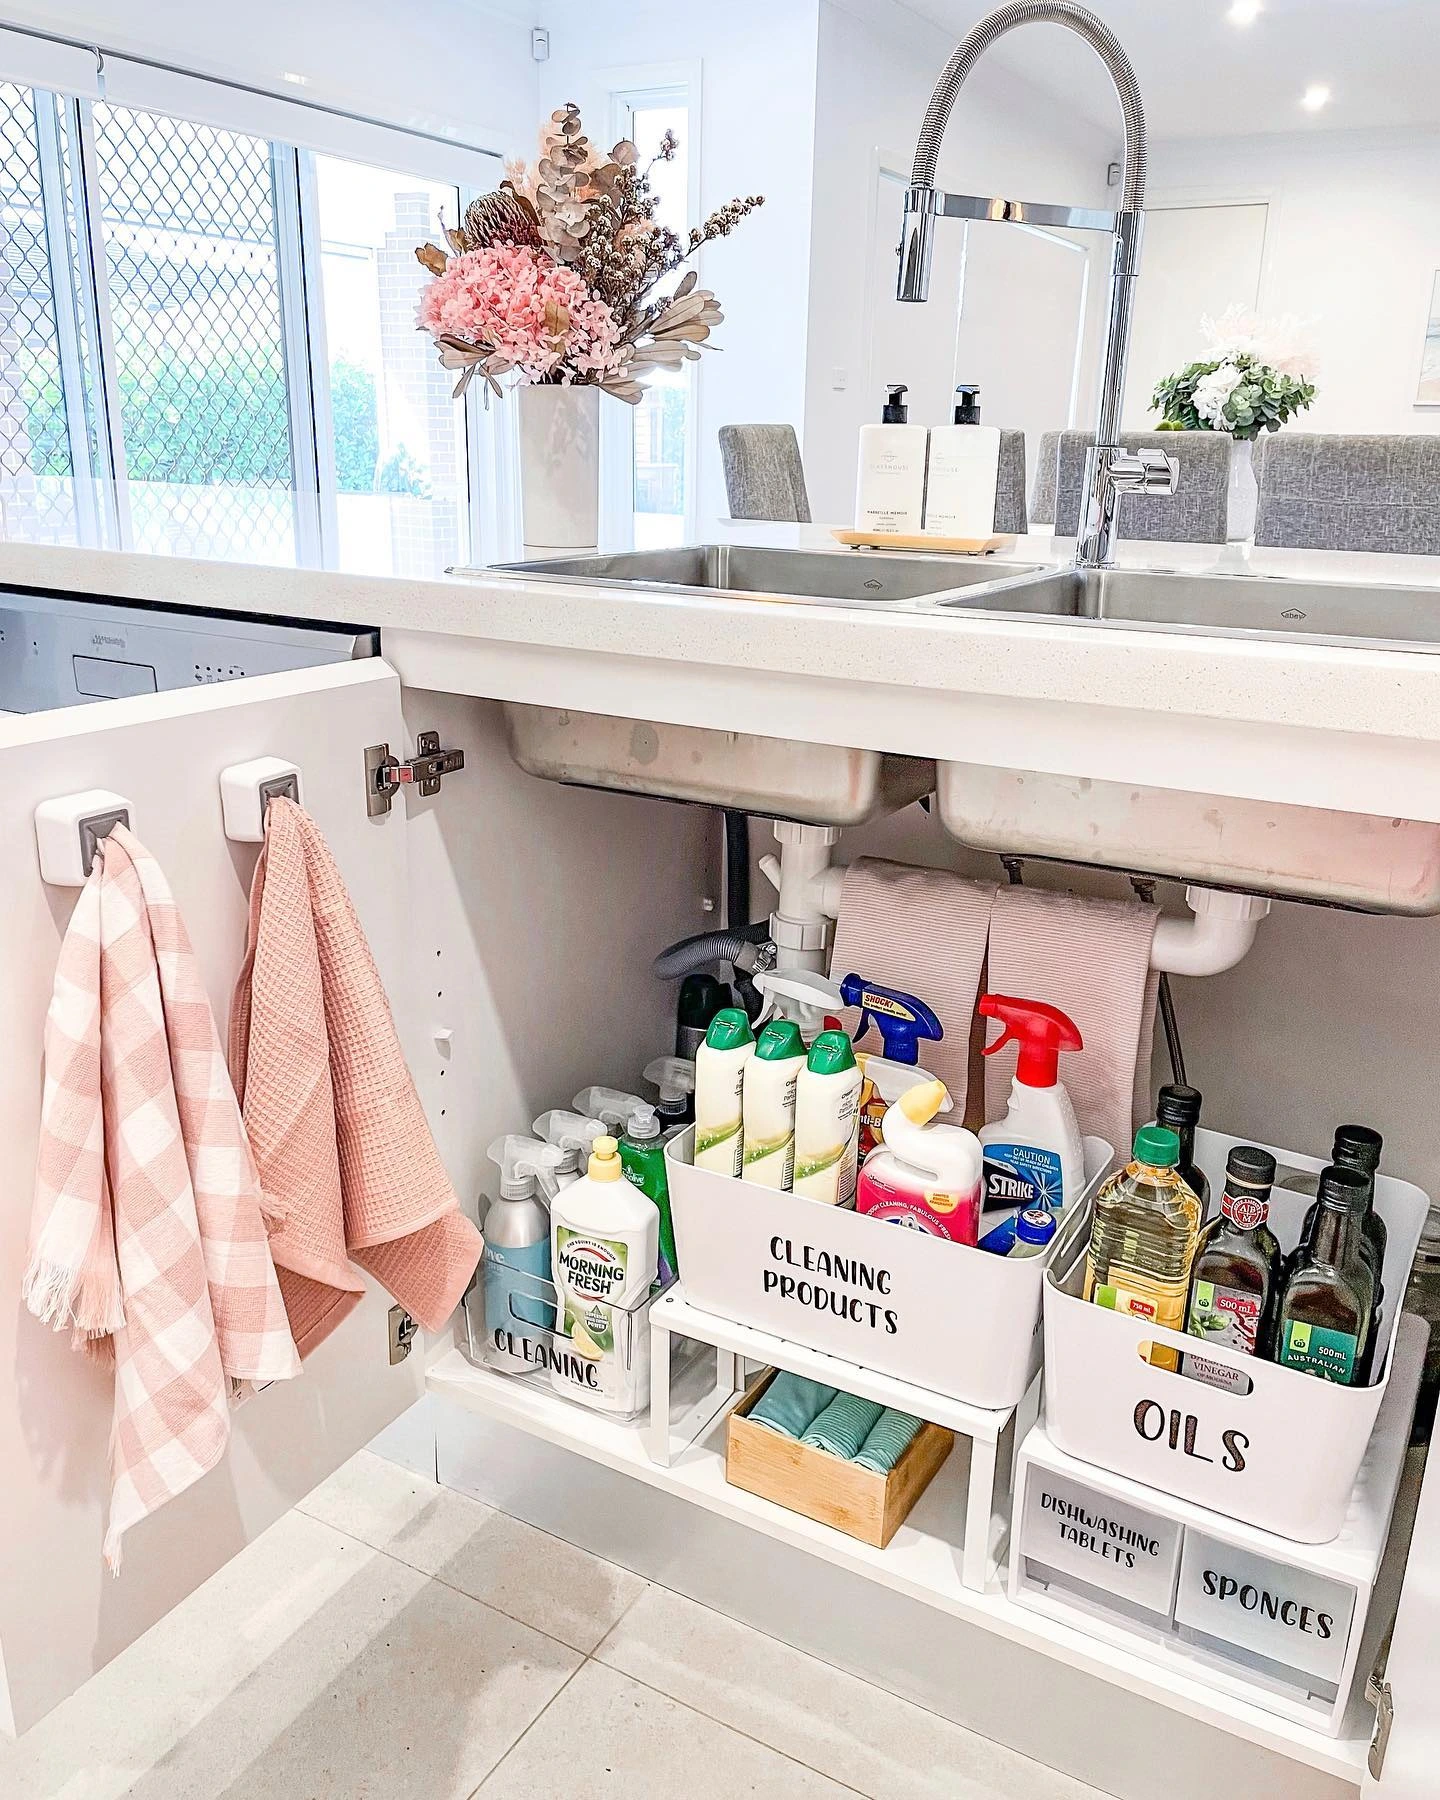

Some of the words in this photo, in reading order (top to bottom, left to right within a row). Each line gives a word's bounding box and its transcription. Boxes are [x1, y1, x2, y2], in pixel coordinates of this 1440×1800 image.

[864, 994, 894, 1009] SHOCK!
[1013, 1147, 1051, 1165] CAUTION
[988, 1173, 1034, 1199] STRIKE
[909, 1204, 939, 1225] FABULOUS
[559, 1251, 624, 1281] MORNING
[770, 1236, 891, 1295] CLEANING
[568, 1270, 611, 1295] FRESH
[763, 1269, 898, 1334] PRODUCTS
[1132, 1302, 1143, 1310] 750
[494, 1328, 598, 1387] CLEANING
[1193, 1361, 1239, 1381] VINEGAR
[1287, 1354, 1346, 1374] AUSTRALIAN
[1133, 1399, 1250, 1472] OILS
[1040, 1492, 1160, 1557] DISHWASHING
[1058, 1522, 1135, 1568] TABLETS
[1202, 1570, 1334, 1639] SPONGES
